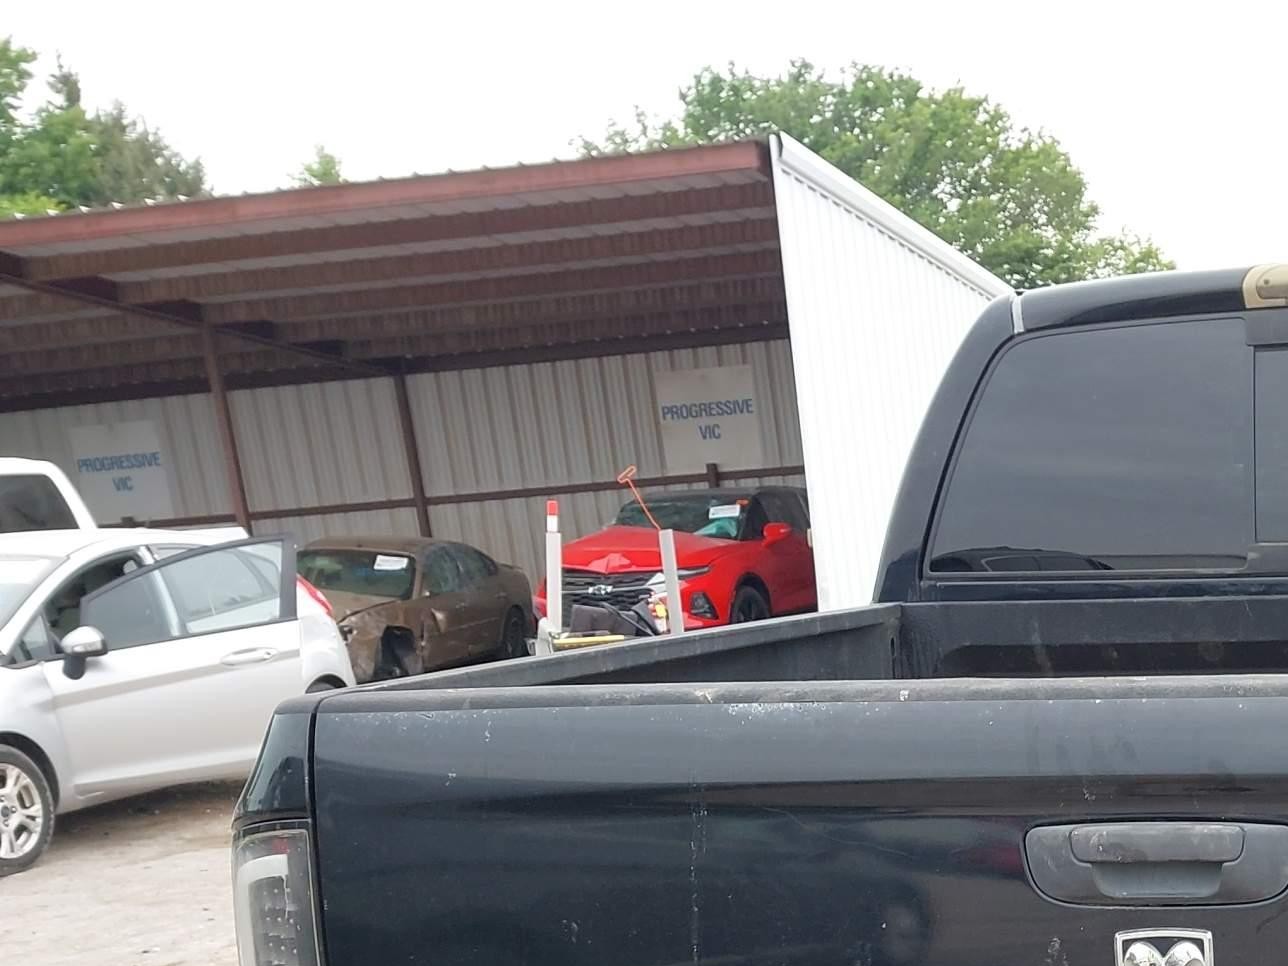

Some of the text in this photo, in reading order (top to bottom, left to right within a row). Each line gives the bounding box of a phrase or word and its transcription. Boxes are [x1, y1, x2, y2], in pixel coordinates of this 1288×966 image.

[661, 399, 753, 420] PROGRESSIVE
[699, 424, 721, 440] VIC
[78, 452, 161, 472] PROGRESSIVE
[112, 476, 134, 491] VIC
